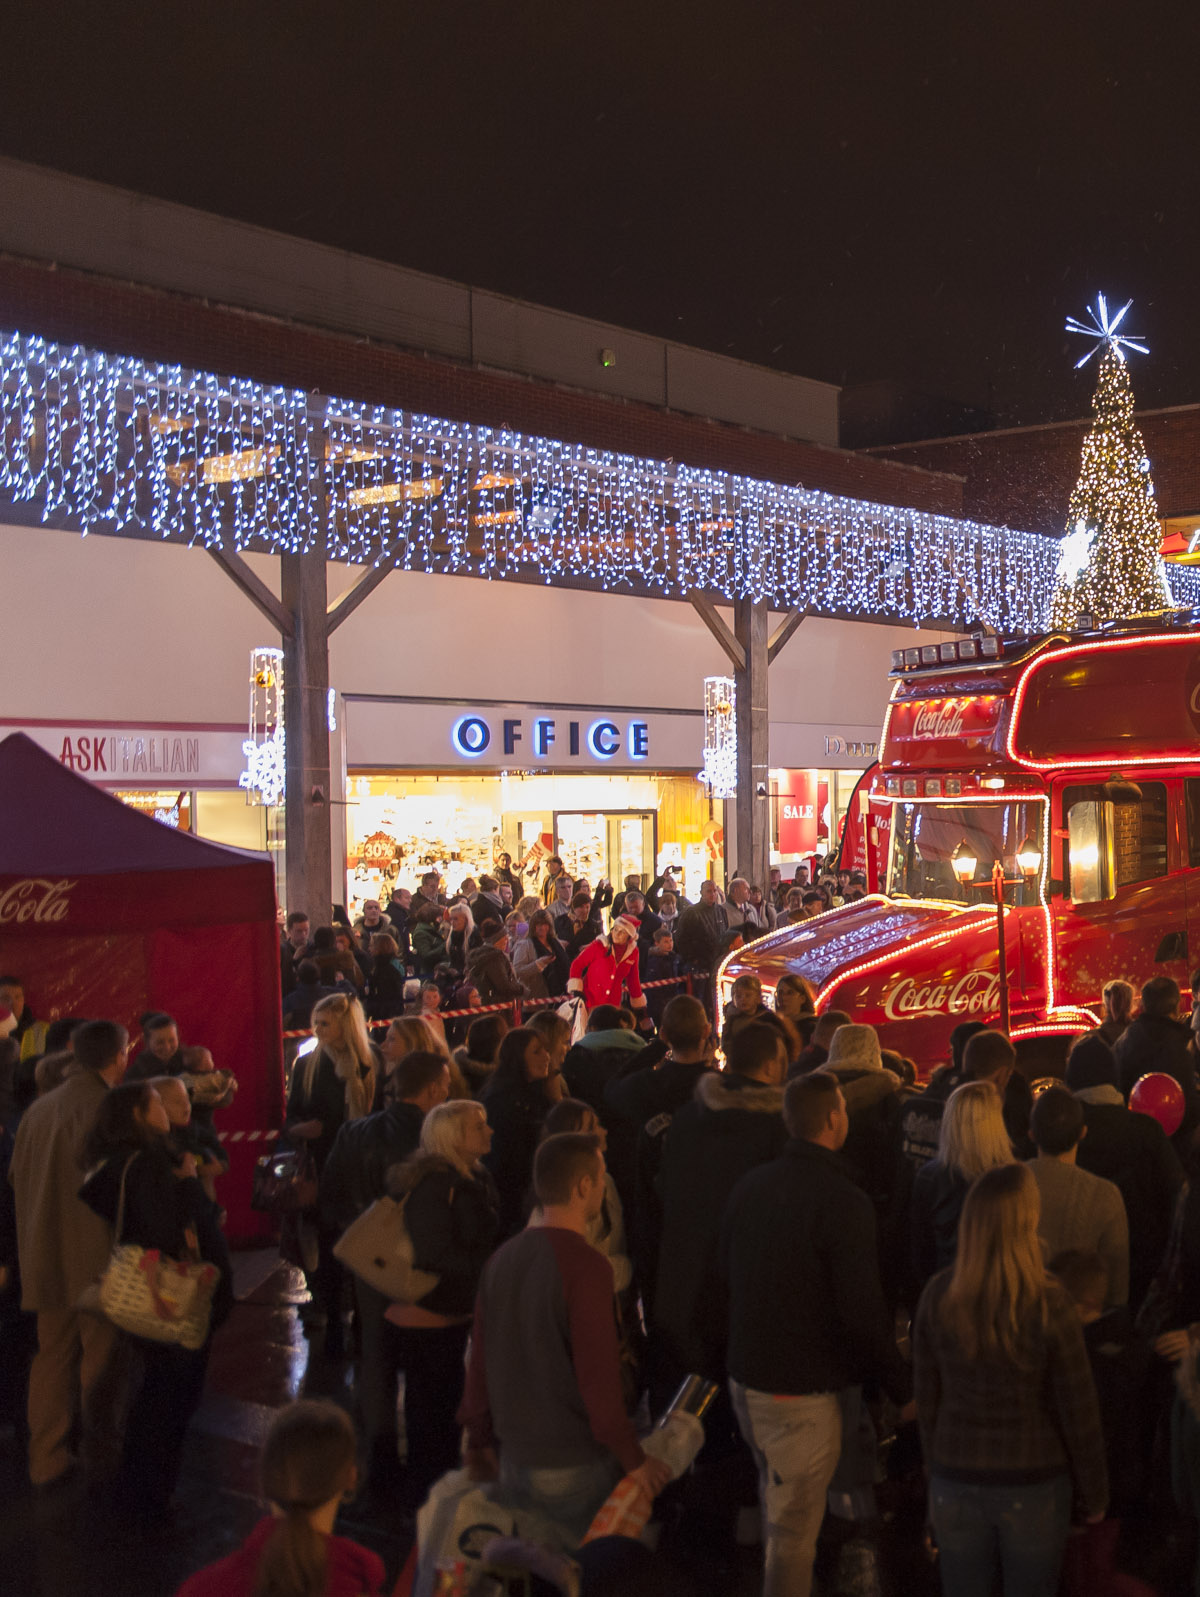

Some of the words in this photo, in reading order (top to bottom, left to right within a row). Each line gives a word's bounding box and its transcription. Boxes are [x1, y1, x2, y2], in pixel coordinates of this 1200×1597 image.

[913, 700, 971, 739] Coca-Cola
[457, 716, 649, 757] OFFICE
[824, 735, 880, 757] Dun
[783, 804, 814, 819] SALE
[858, 812, 891, 830] Hllo!
[365, 843, 393, 858] 30%
